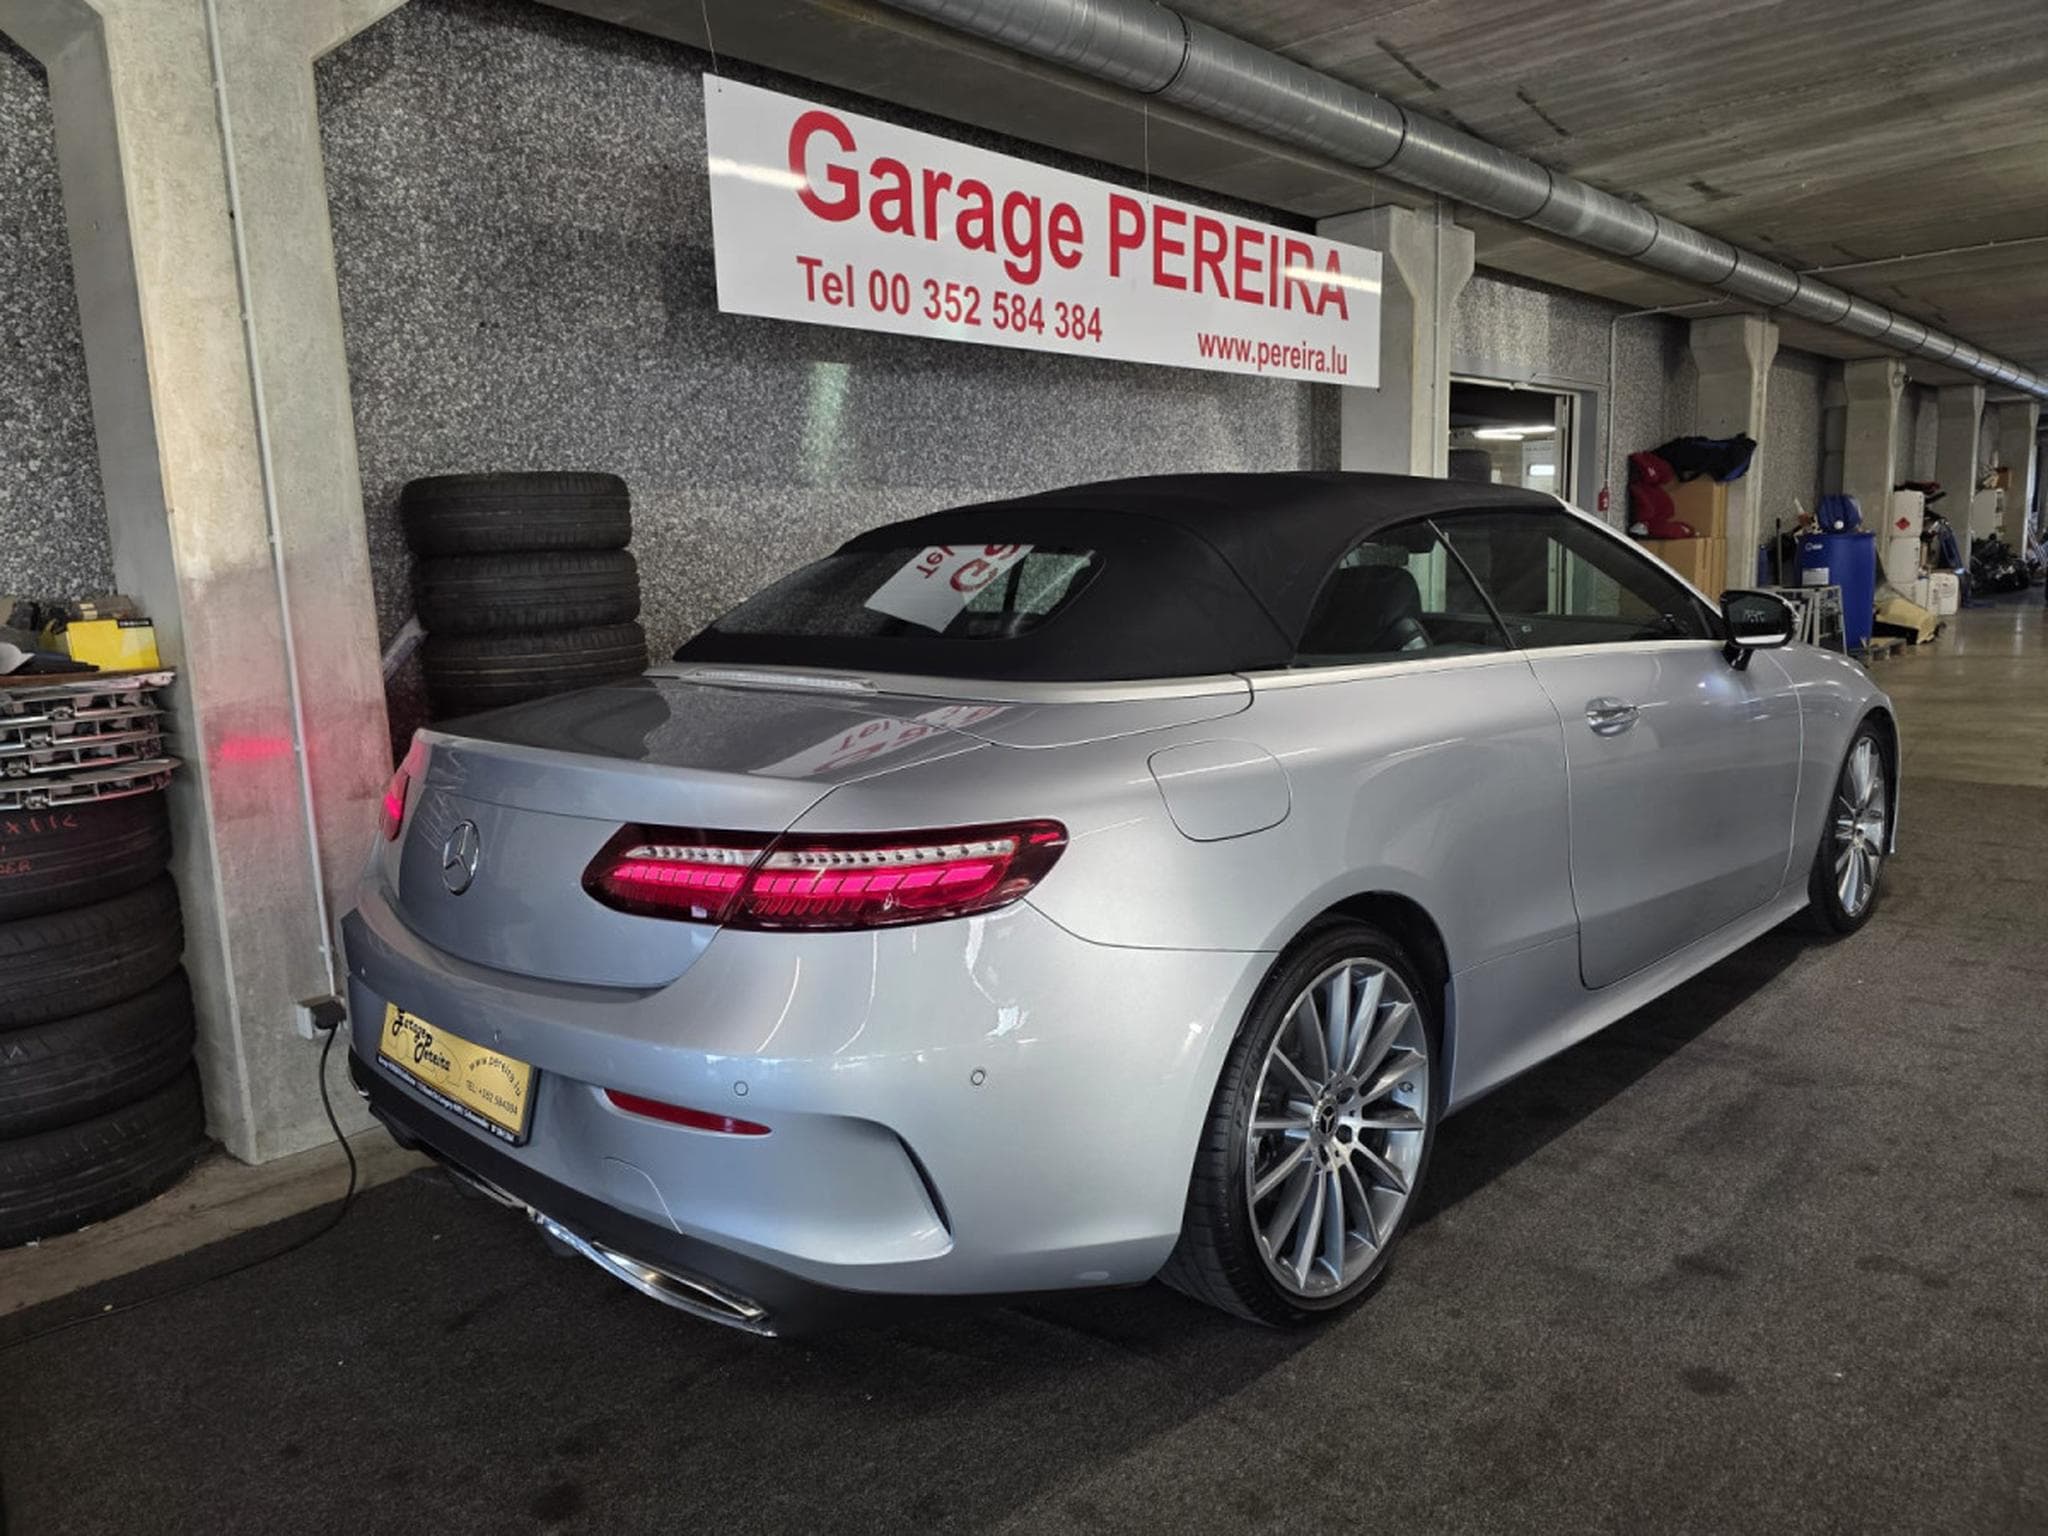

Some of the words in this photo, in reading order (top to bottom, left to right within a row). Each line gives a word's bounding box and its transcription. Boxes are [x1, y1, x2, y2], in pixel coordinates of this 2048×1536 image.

[787, 109, 1085, 286] Garage
[1107, 193, 1349, 321] PEREIRA
[796, 255, 855, 307] Tel
[867, 268, 911, 316] 00
[923, 278, 983, 327] 352
[992, 290, 1046, 334] 584
[1054, 301, 1103, 342] 384
[1198, 333, 1349, 376] www.pereira.lu
